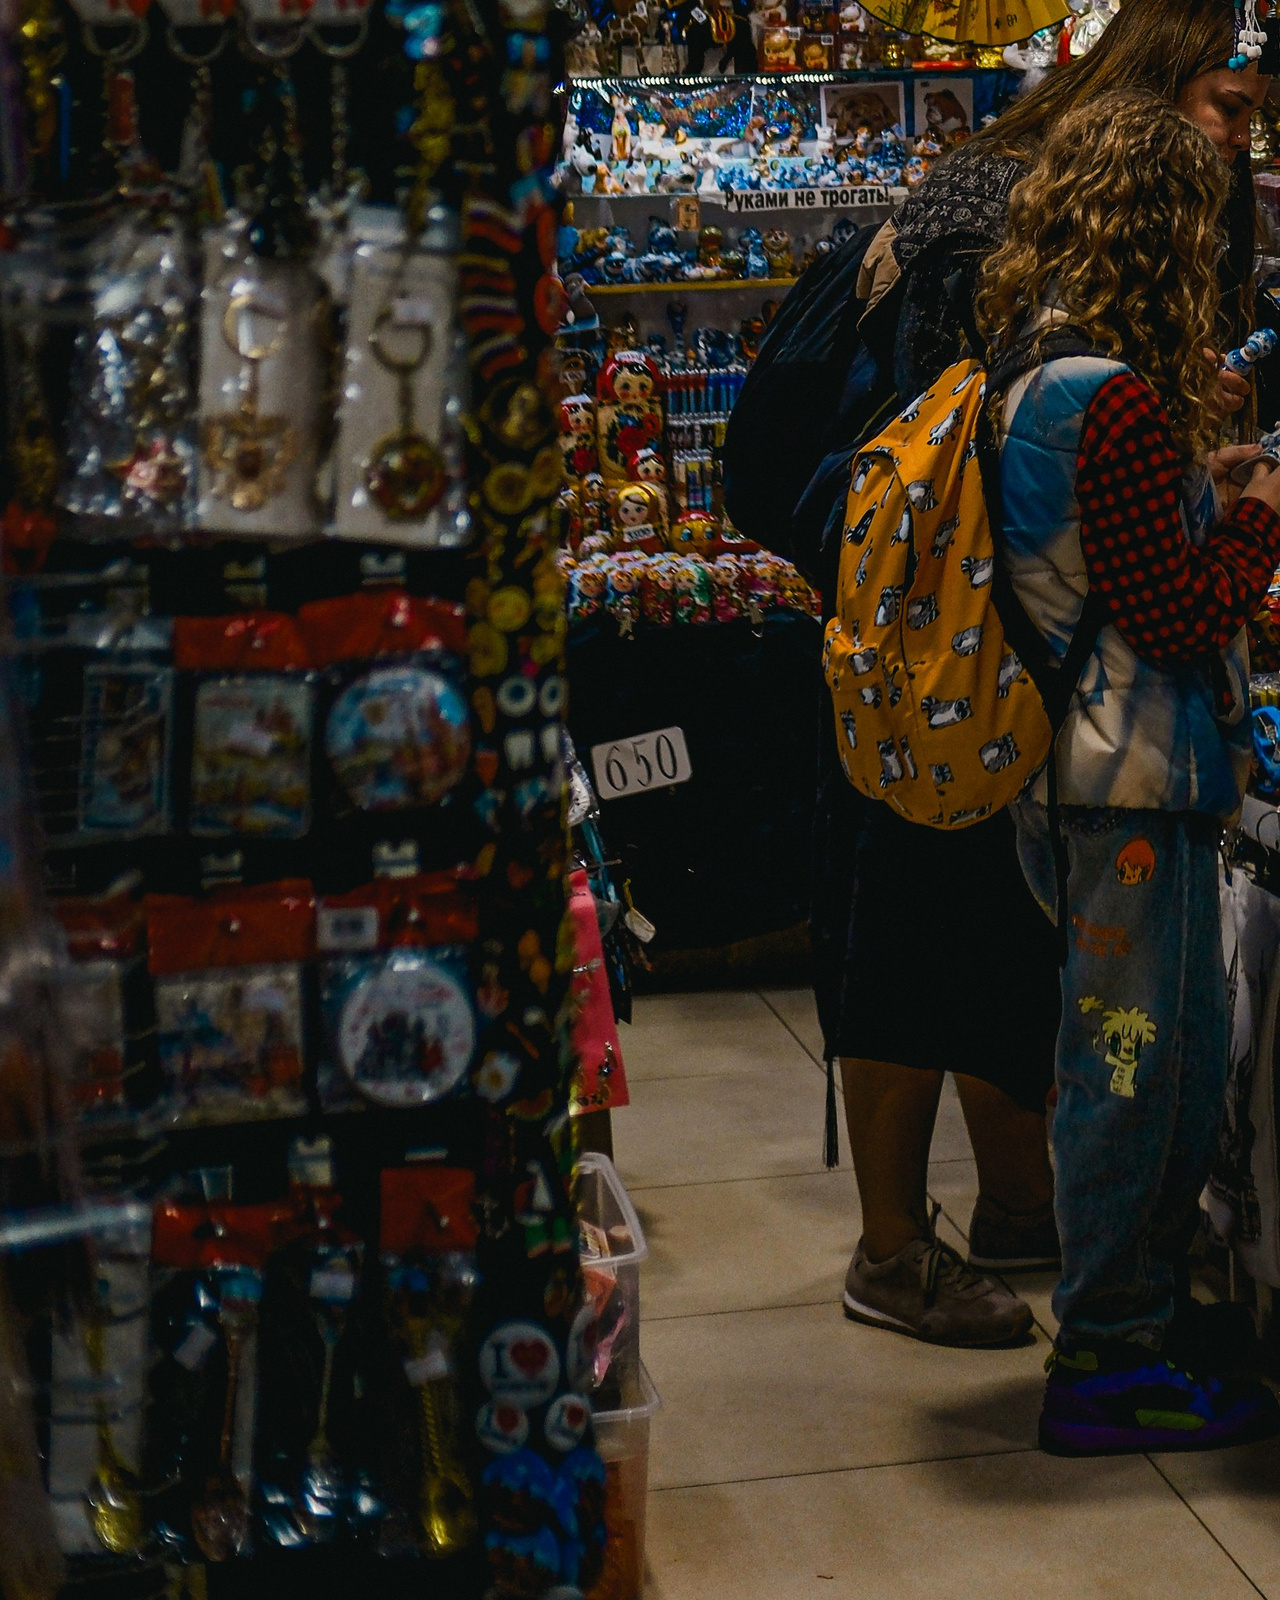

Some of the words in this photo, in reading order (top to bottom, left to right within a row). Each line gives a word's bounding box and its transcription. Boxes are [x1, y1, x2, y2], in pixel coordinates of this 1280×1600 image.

[725, 189, 788, 212] Руками
[795, 192, 815, 206] не
[820, 186, 889, 207] трогать!
[606, 734, 677, 791] 650
